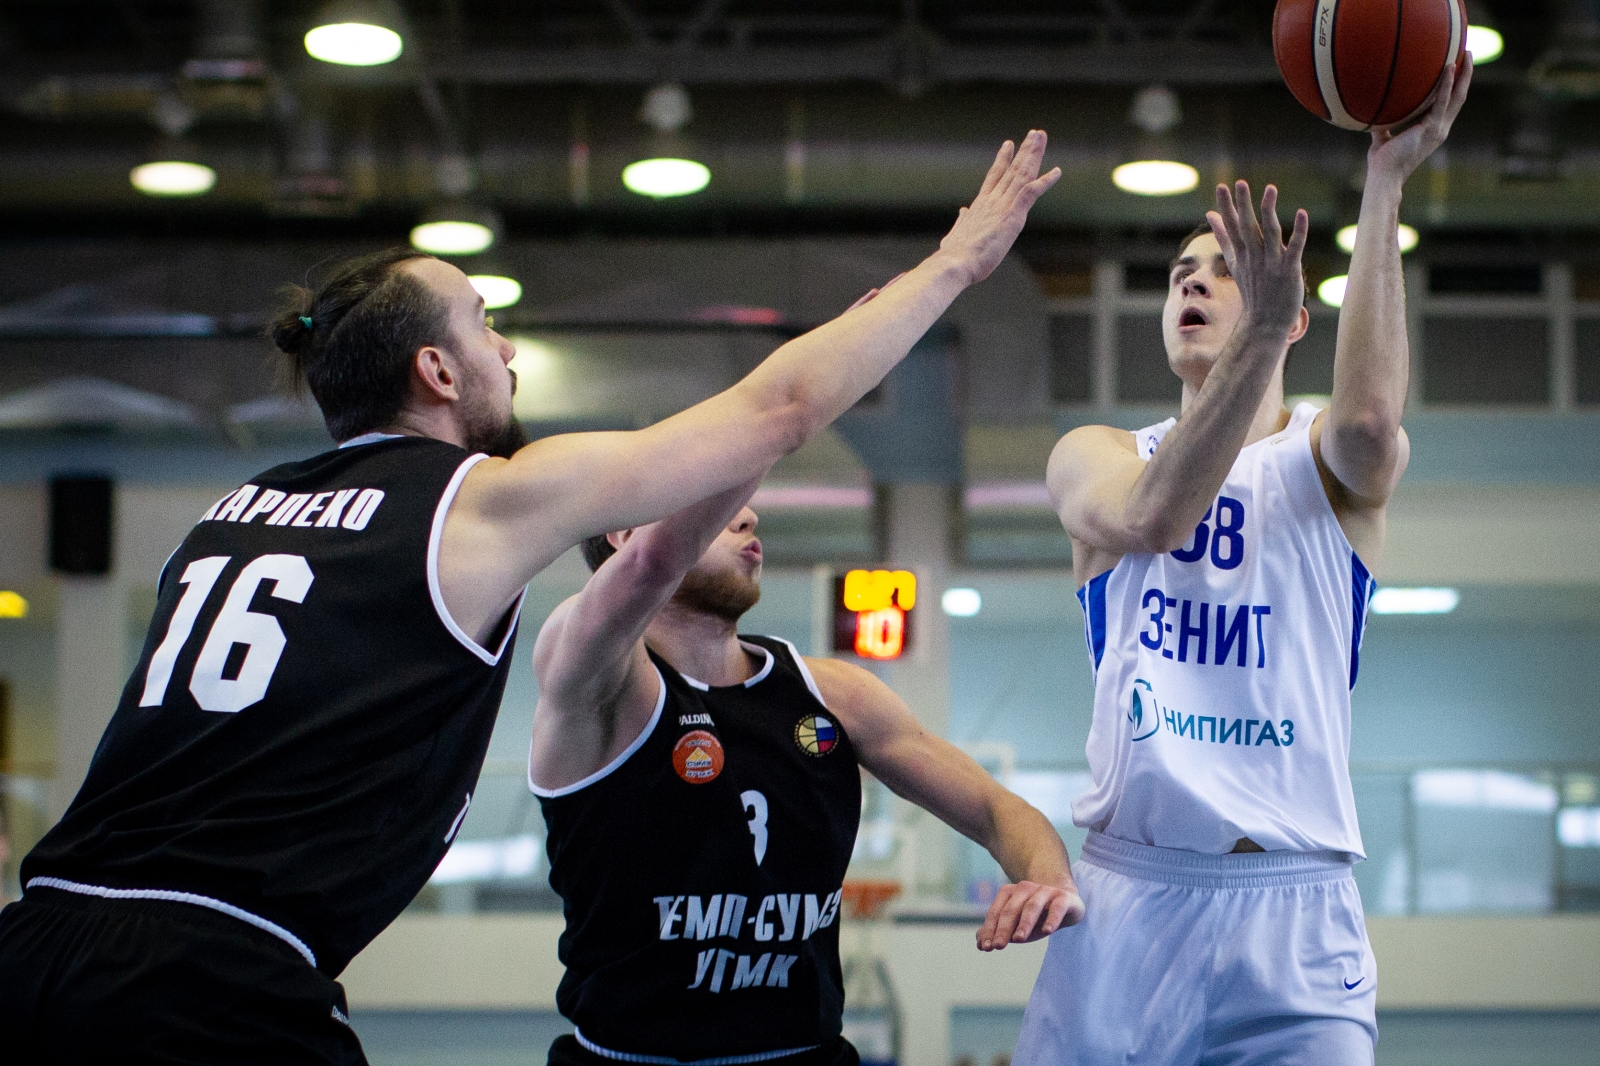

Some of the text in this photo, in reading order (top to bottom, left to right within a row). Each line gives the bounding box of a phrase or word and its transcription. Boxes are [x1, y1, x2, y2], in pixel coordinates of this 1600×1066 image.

[1319, 6, 1329, 47] GF7X
[138, 553, 315, 713] 16
[1139, 588, 1271, 669] ЗЕНИТ
[1163, 706, 1295, 747] НИПИГАЗ
[740, 789, 769, 867] 3
[653, 887, 842, 942] ТЕМП-СУМЗ
[686, 948, 799, 994] УГМК
